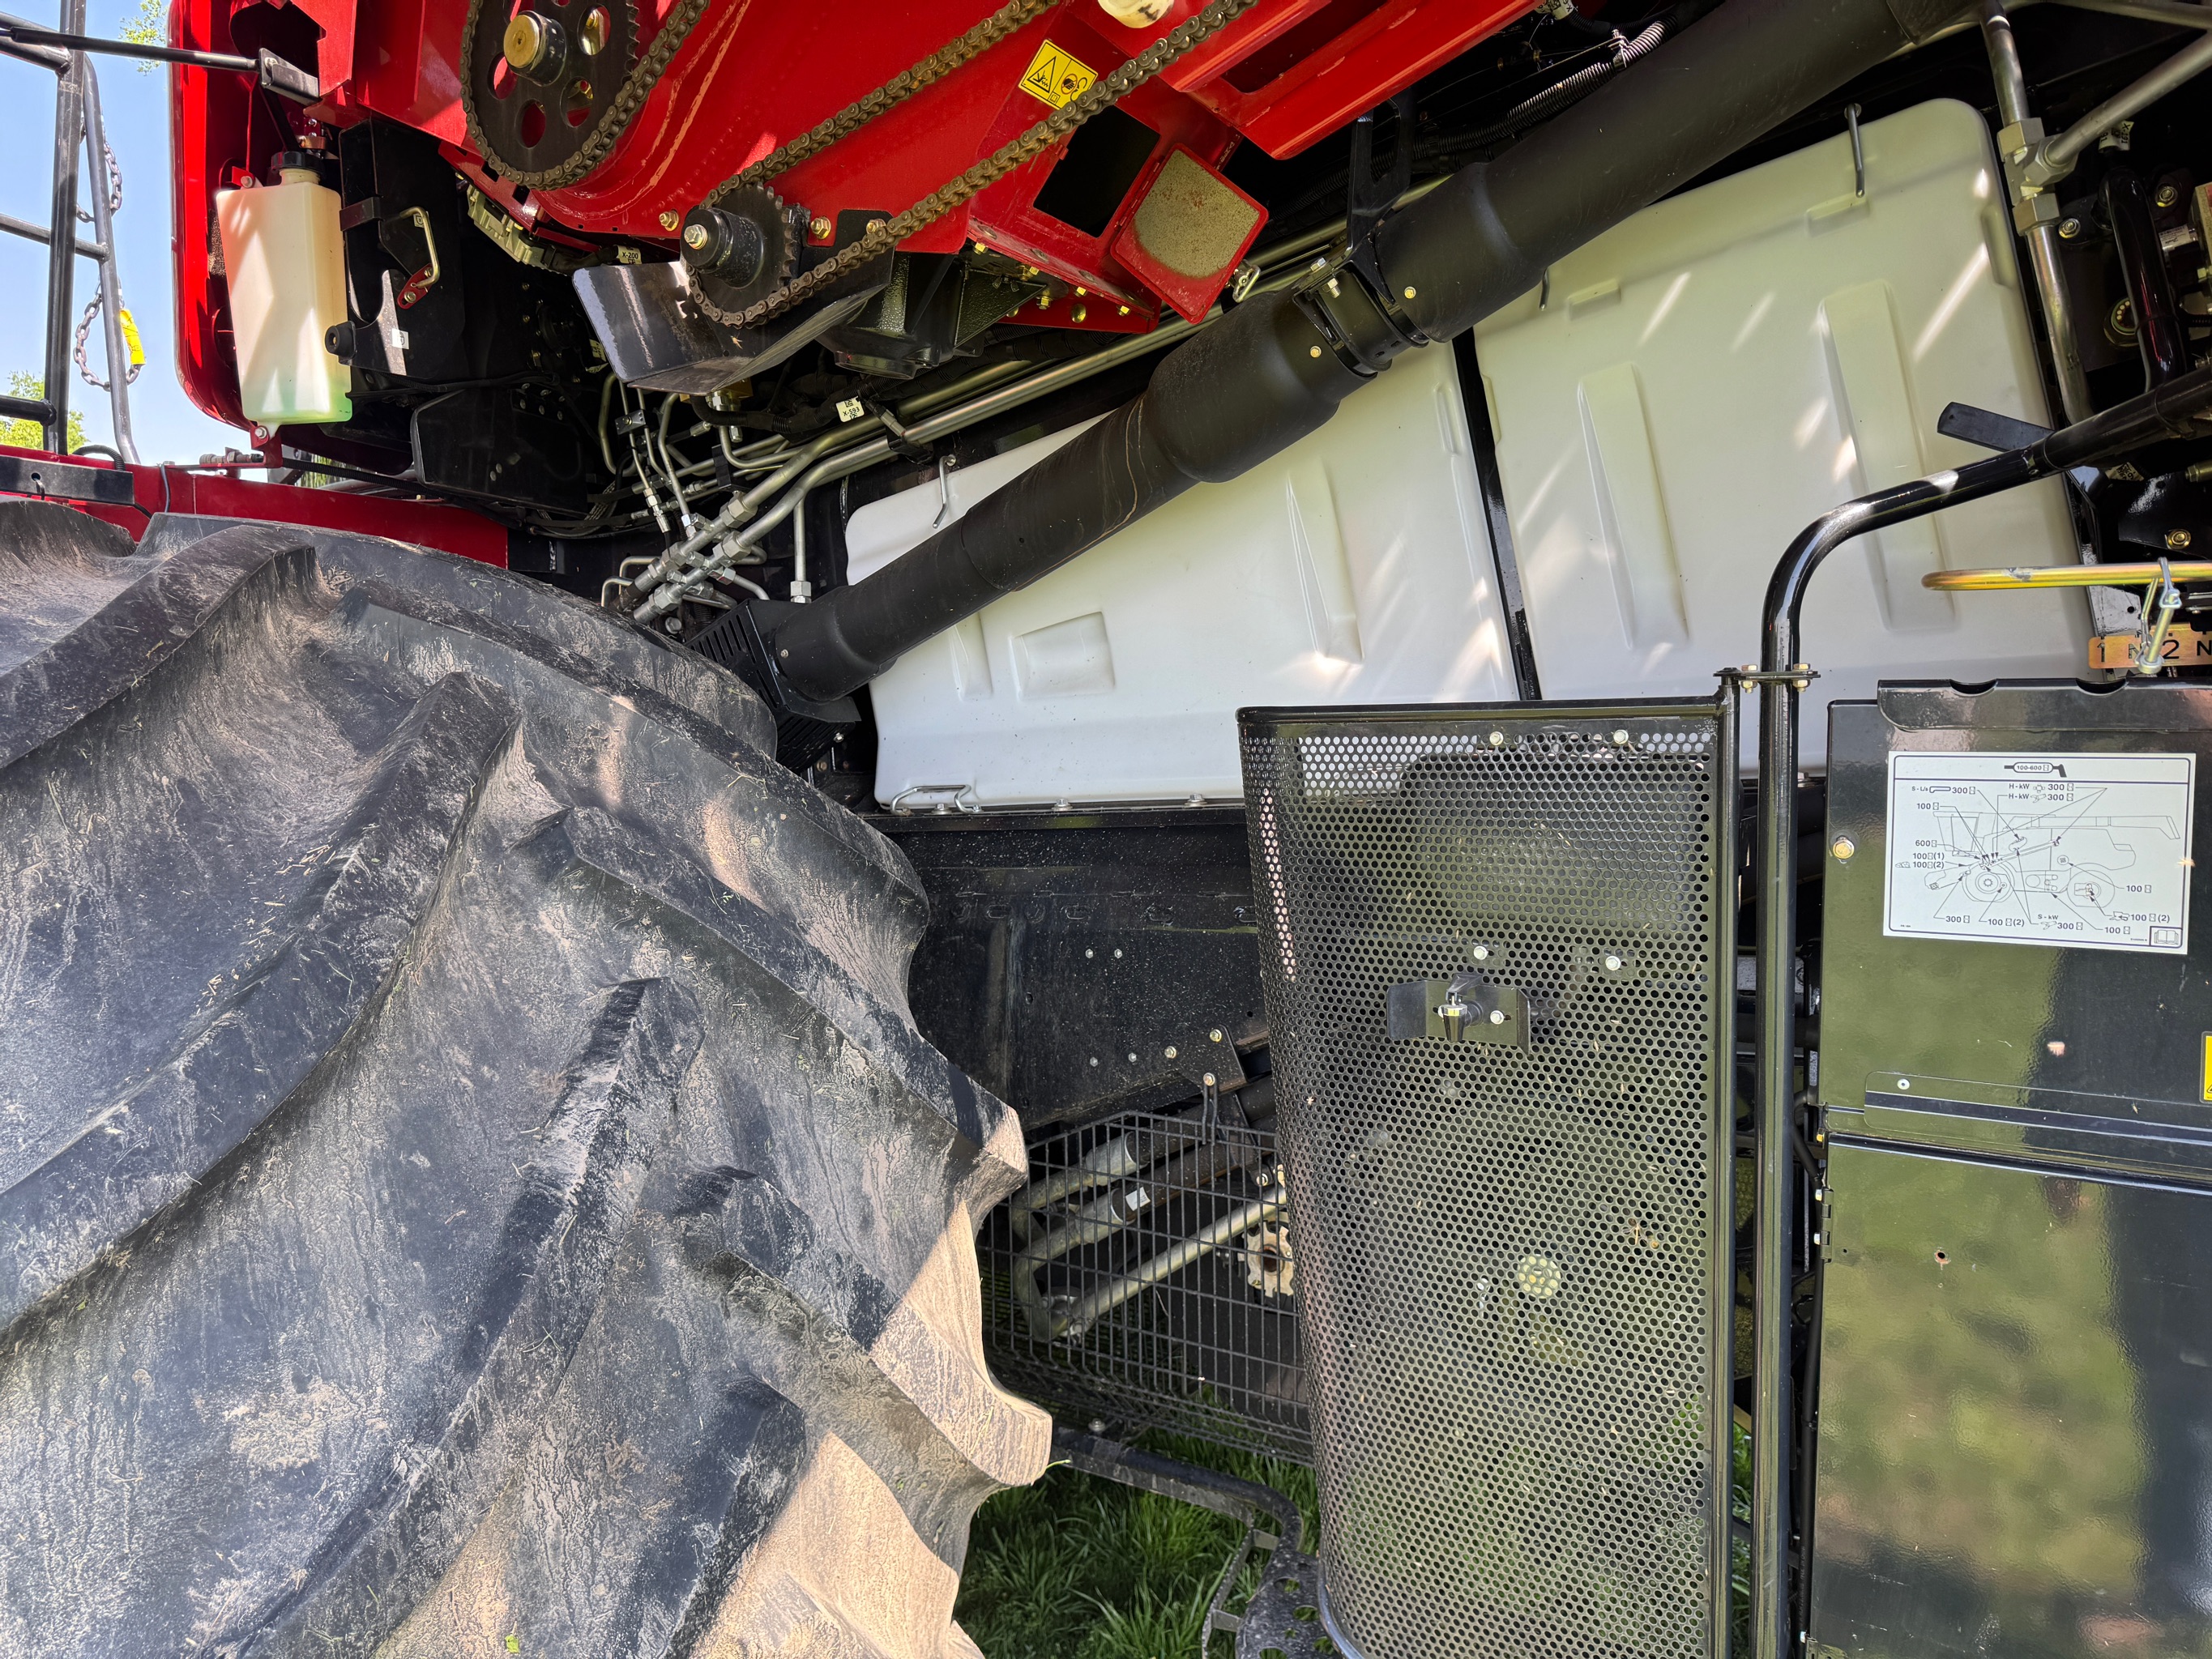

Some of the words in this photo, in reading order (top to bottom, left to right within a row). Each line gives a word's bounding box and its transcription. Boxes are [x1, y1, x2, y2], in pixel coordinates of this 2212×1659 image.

[843, 407, 860, 416] X-593
[2097, 642, 2105, 663] 1
[2163, 639, 2180, 659] 2
[2197, 640, 2212, 655] N
[1933, 852, 1945, 860] (1)
[1933, 861, 1945, 869] (2)
[2013, 919, 2024, 927] (2)
[2158, 915, 2170, 923] (2)
